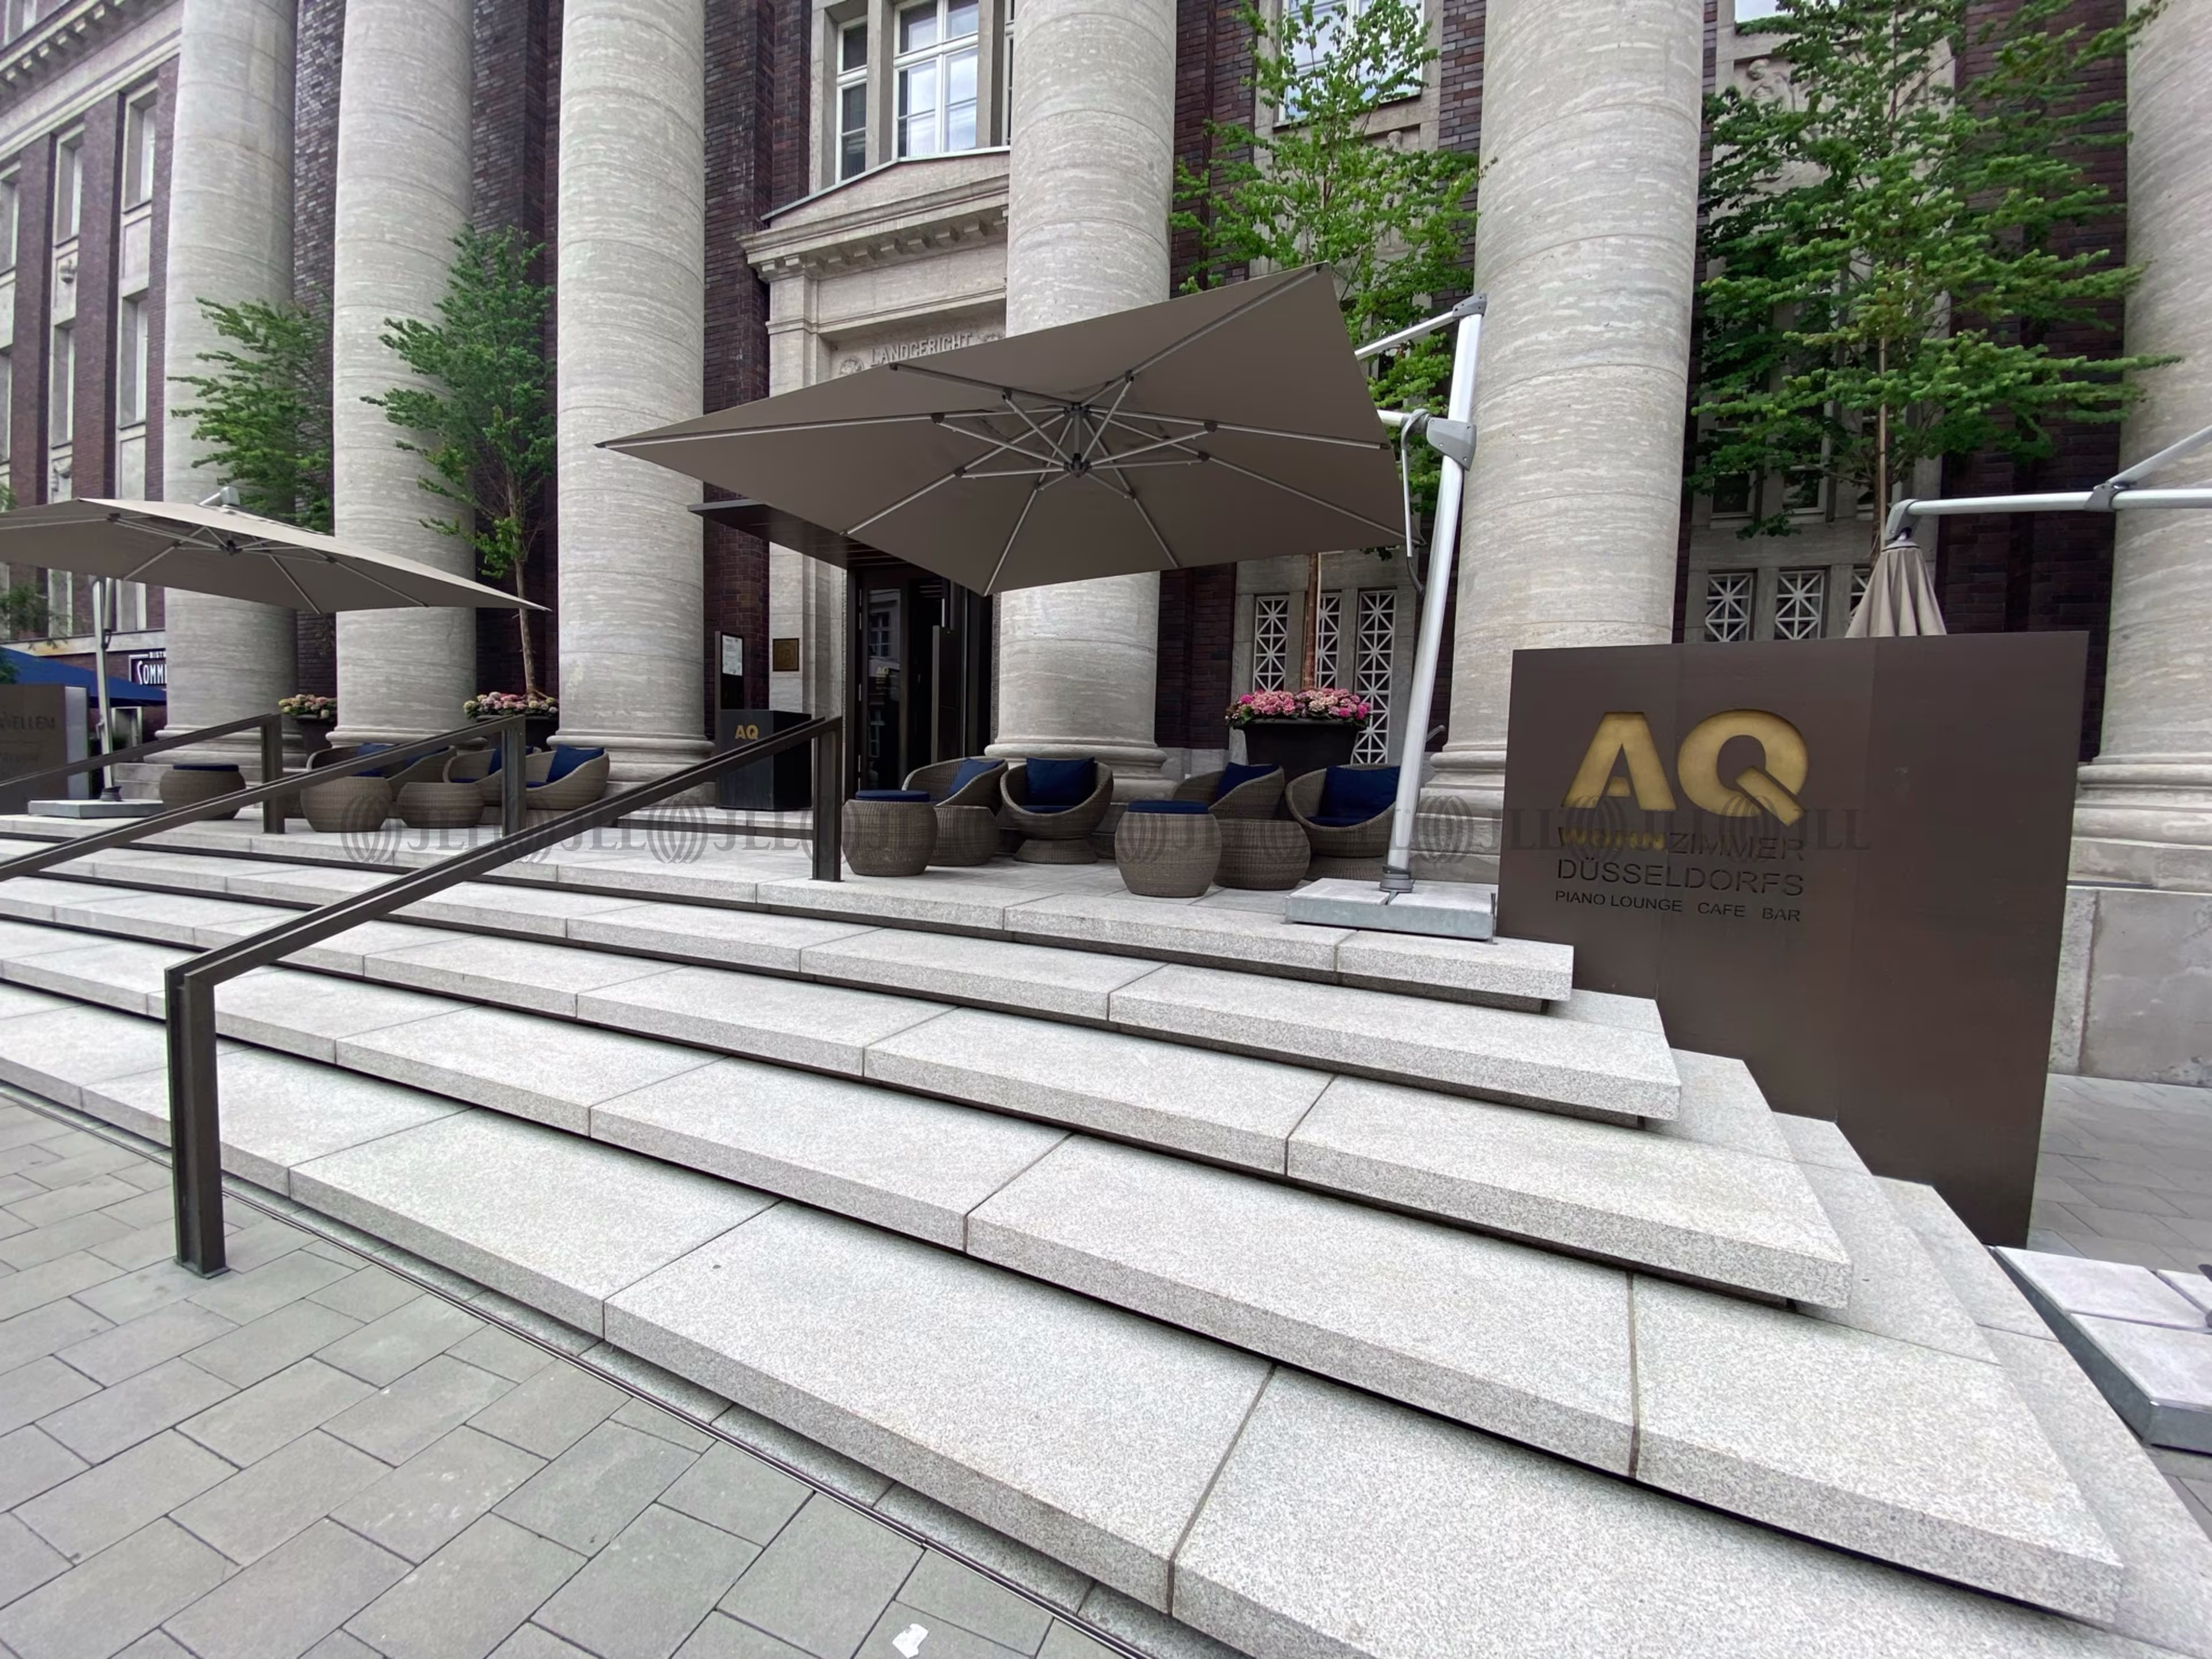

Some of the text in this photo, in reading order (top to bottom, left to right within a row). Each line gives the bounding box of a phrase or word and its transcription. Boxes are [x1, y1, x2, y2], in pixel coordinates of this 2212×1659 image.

[870, 332, 972, 367] LANDGERICHT
[137, 660, 167, 685] SOMM
[734, 724, 759, 740] AQ
[1560, 708, 1808, 827] AQ
[1558, 857, 1804, 896] DÜSSELDORFS
[1555, 890, 1802, 922] PIANO LOUNGE CAFE BAR
